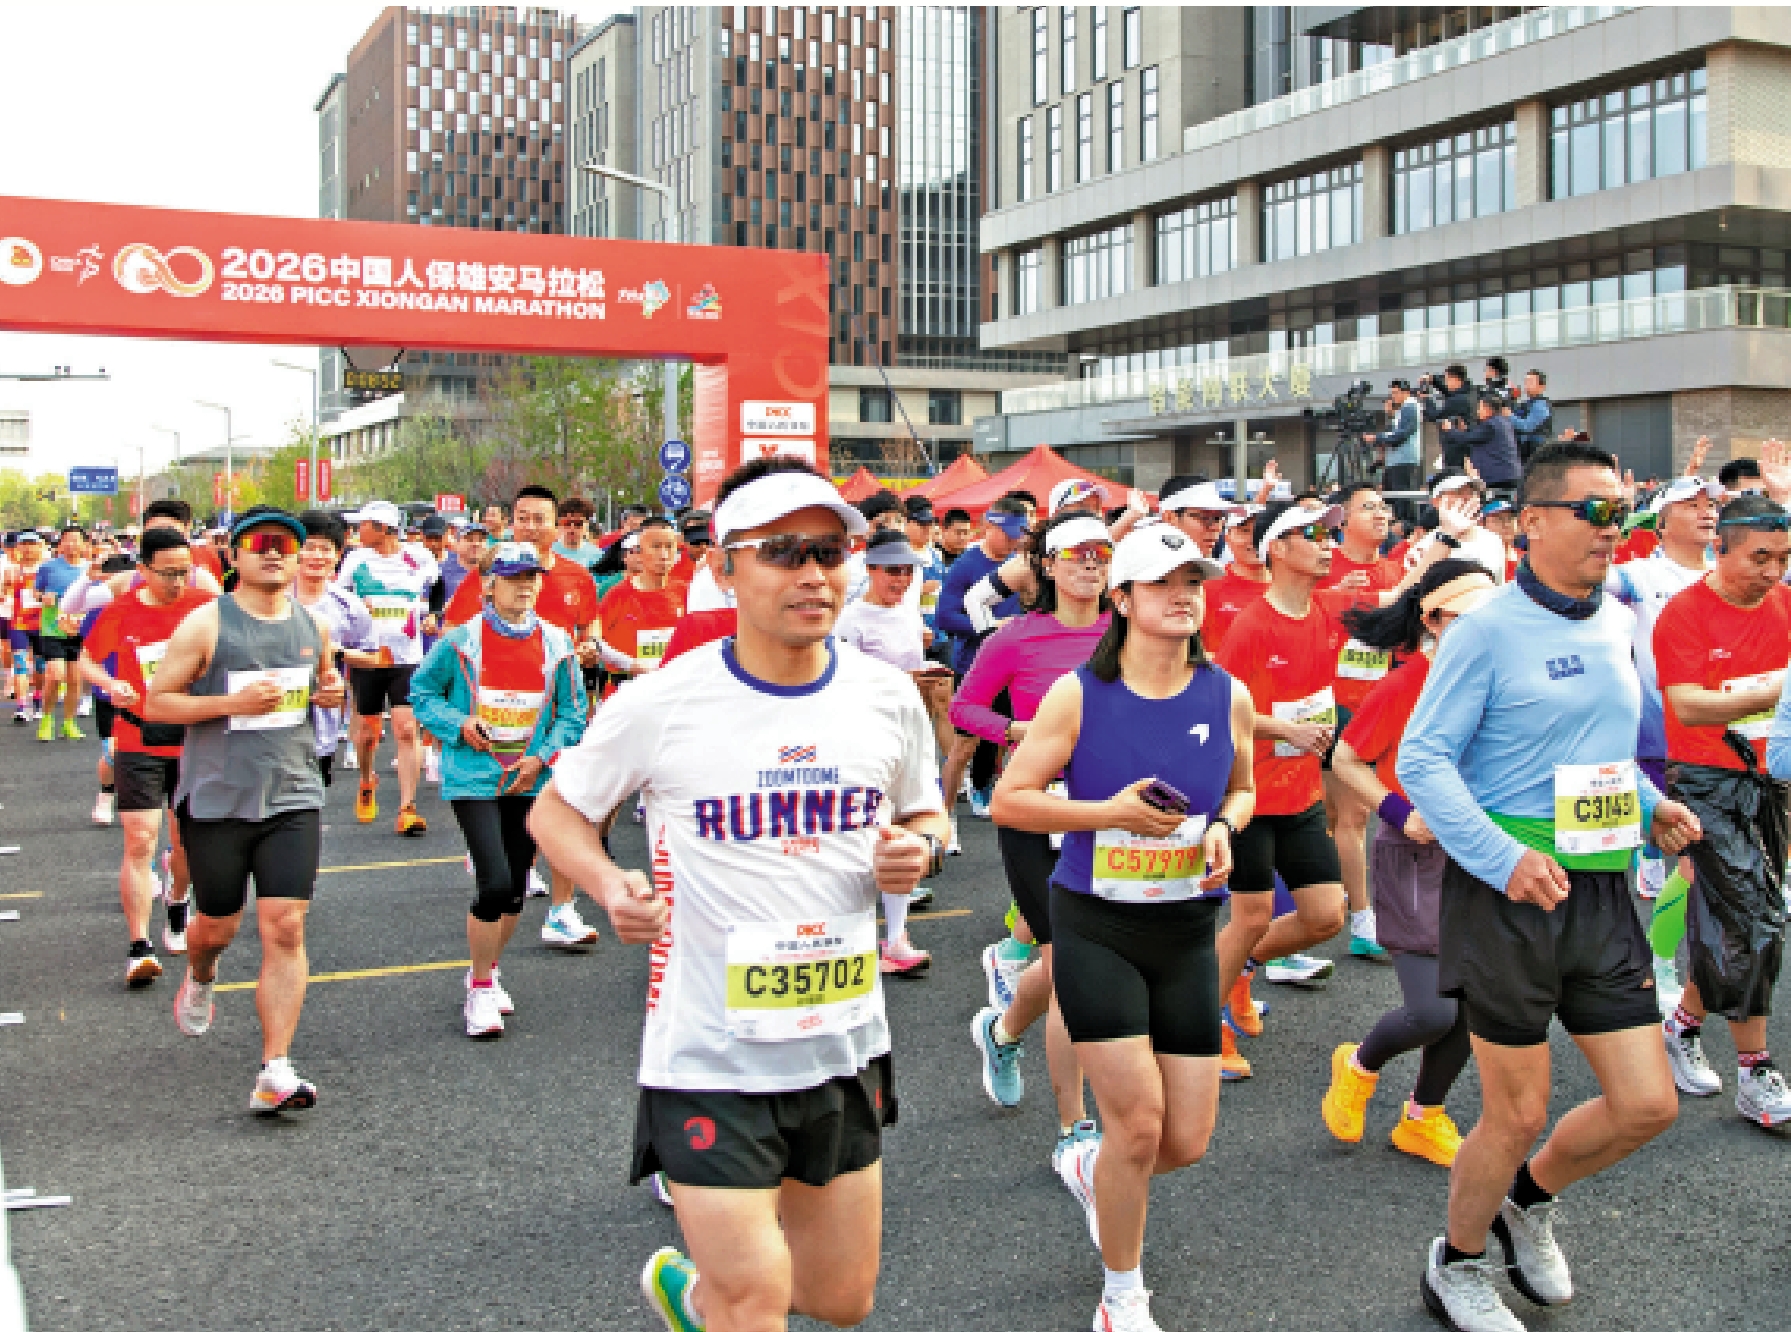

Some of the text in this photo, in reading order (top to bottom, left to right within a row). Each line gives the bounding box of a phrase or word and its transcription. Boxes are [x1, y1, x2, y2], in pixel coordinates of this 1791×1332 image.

[221, 247, 606, 299] 2026中国人保雄安马拉松
[221, 281, 606, 320] 2026 PICC XIONGAN MARATHON
[693, 787, 885, 842] RUNNER
[745, 956, 864, 997] C35702
